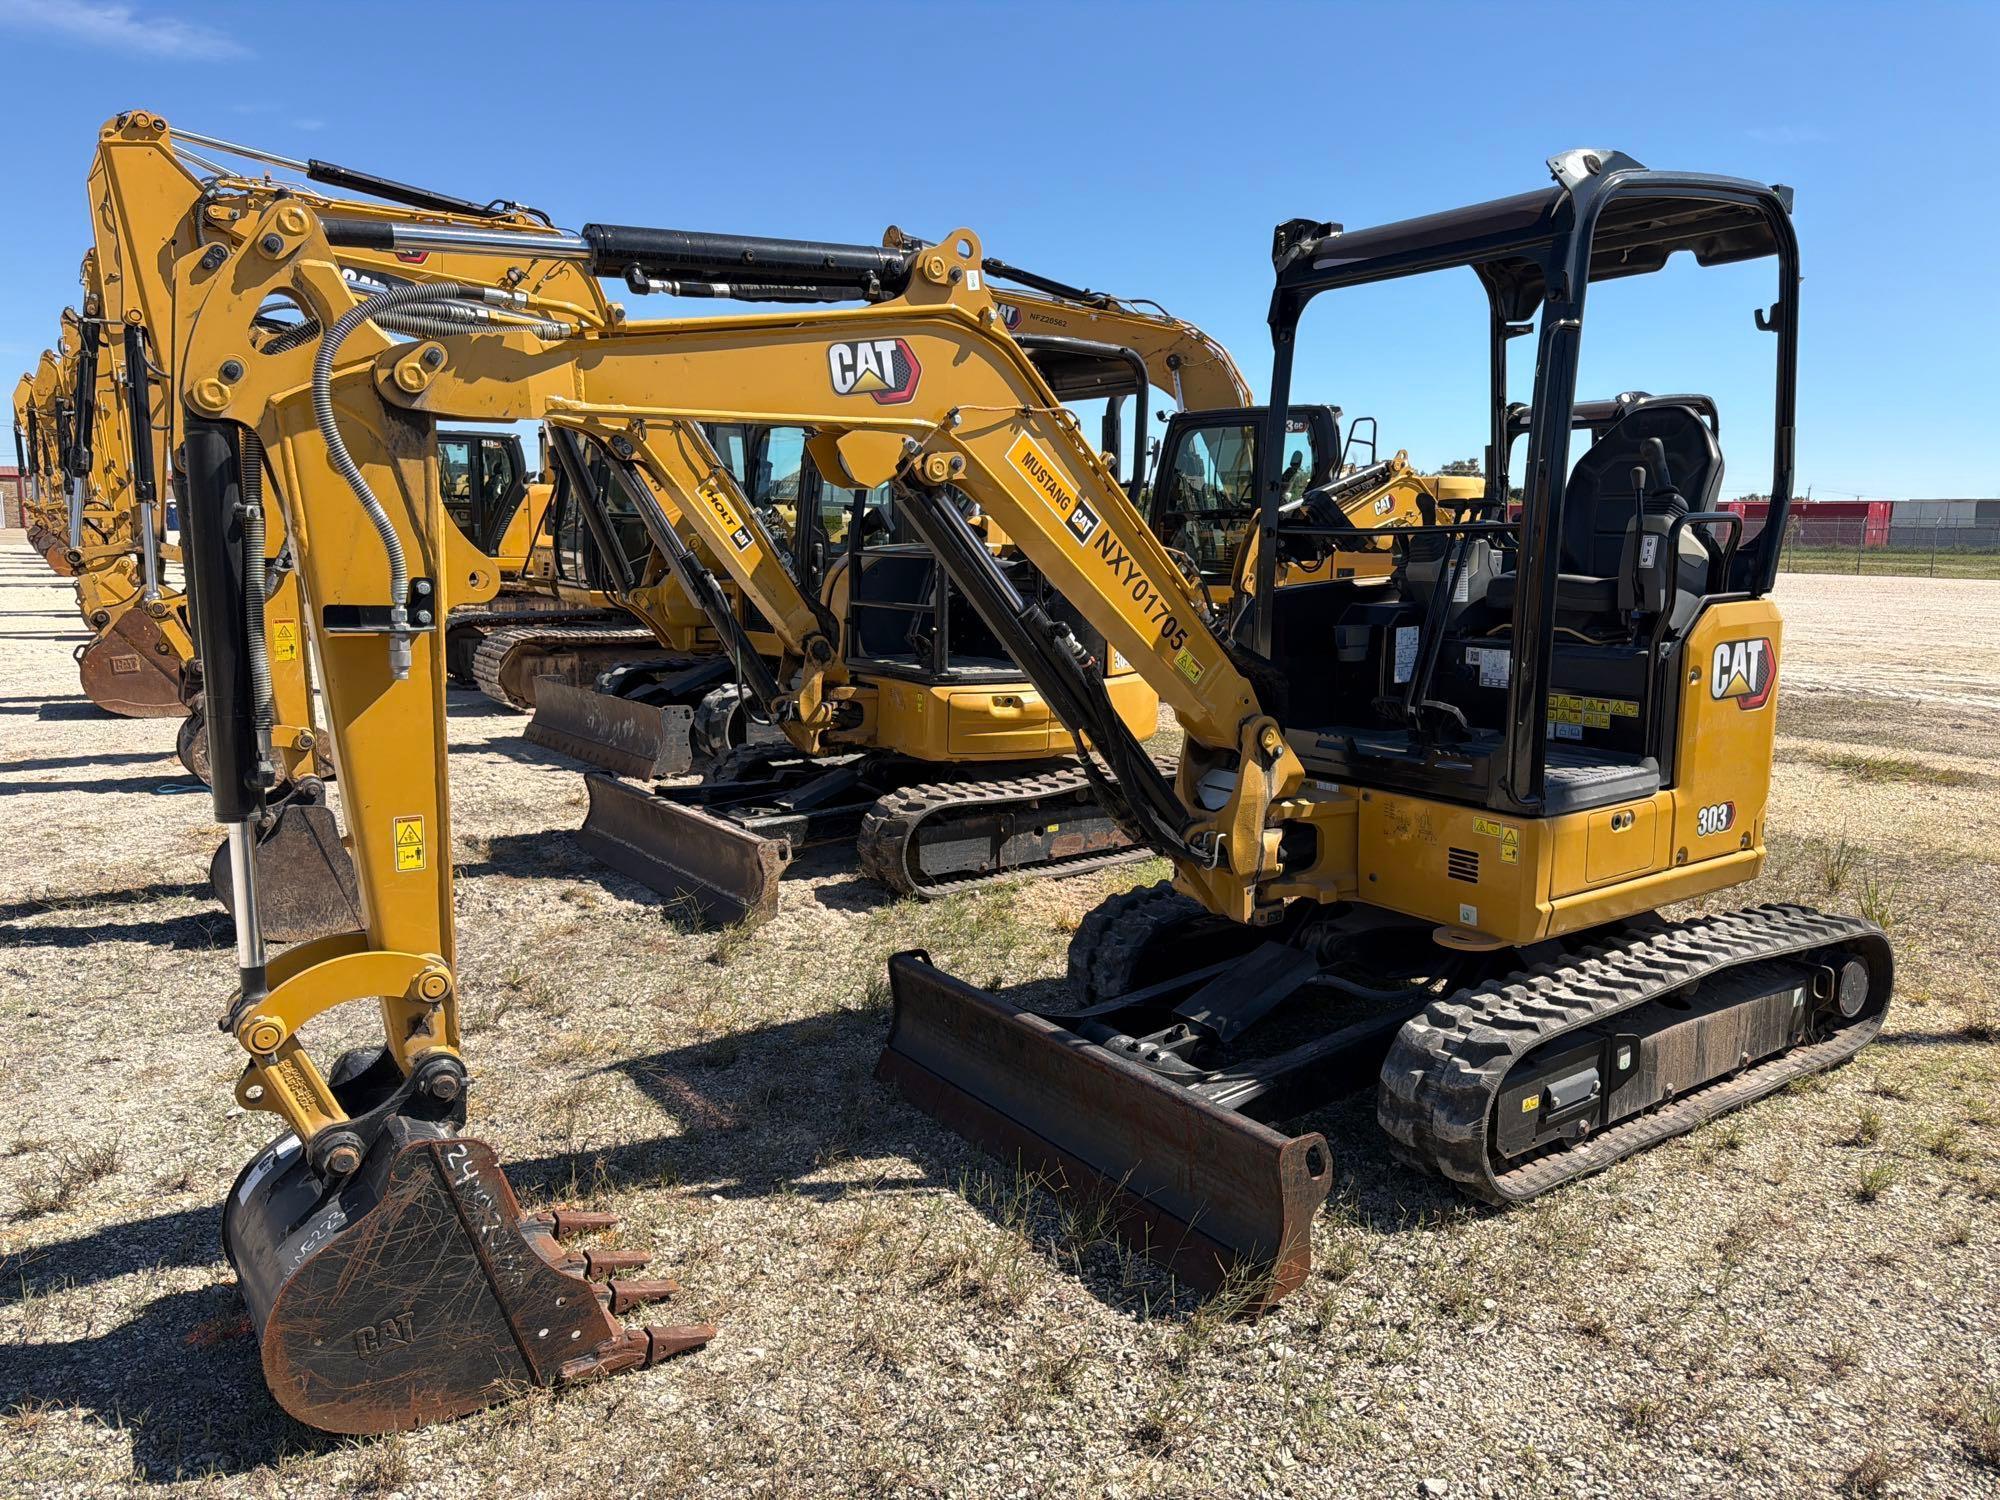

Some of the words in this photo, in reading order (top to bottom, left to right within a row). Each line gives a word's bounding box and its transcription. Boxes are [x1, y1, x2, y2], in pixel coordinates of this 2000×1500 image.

[829, 340, 897, 394] CAT
[706, 488, 736, 526] HOLT
[734, 529, 749, 546] CAT
[1021, 451, 1071, 511] MUSTANG
[1071, 508, 1094, 534] CAT
[1374, 495, 1391, 516] CAT
[1094, 529, 1188, 651] NXY01705
[1712, 640, 1763, 699] CAT
[1697, 803, 1729, 836] 303
[356, 1312, 415, 1361] CAT
